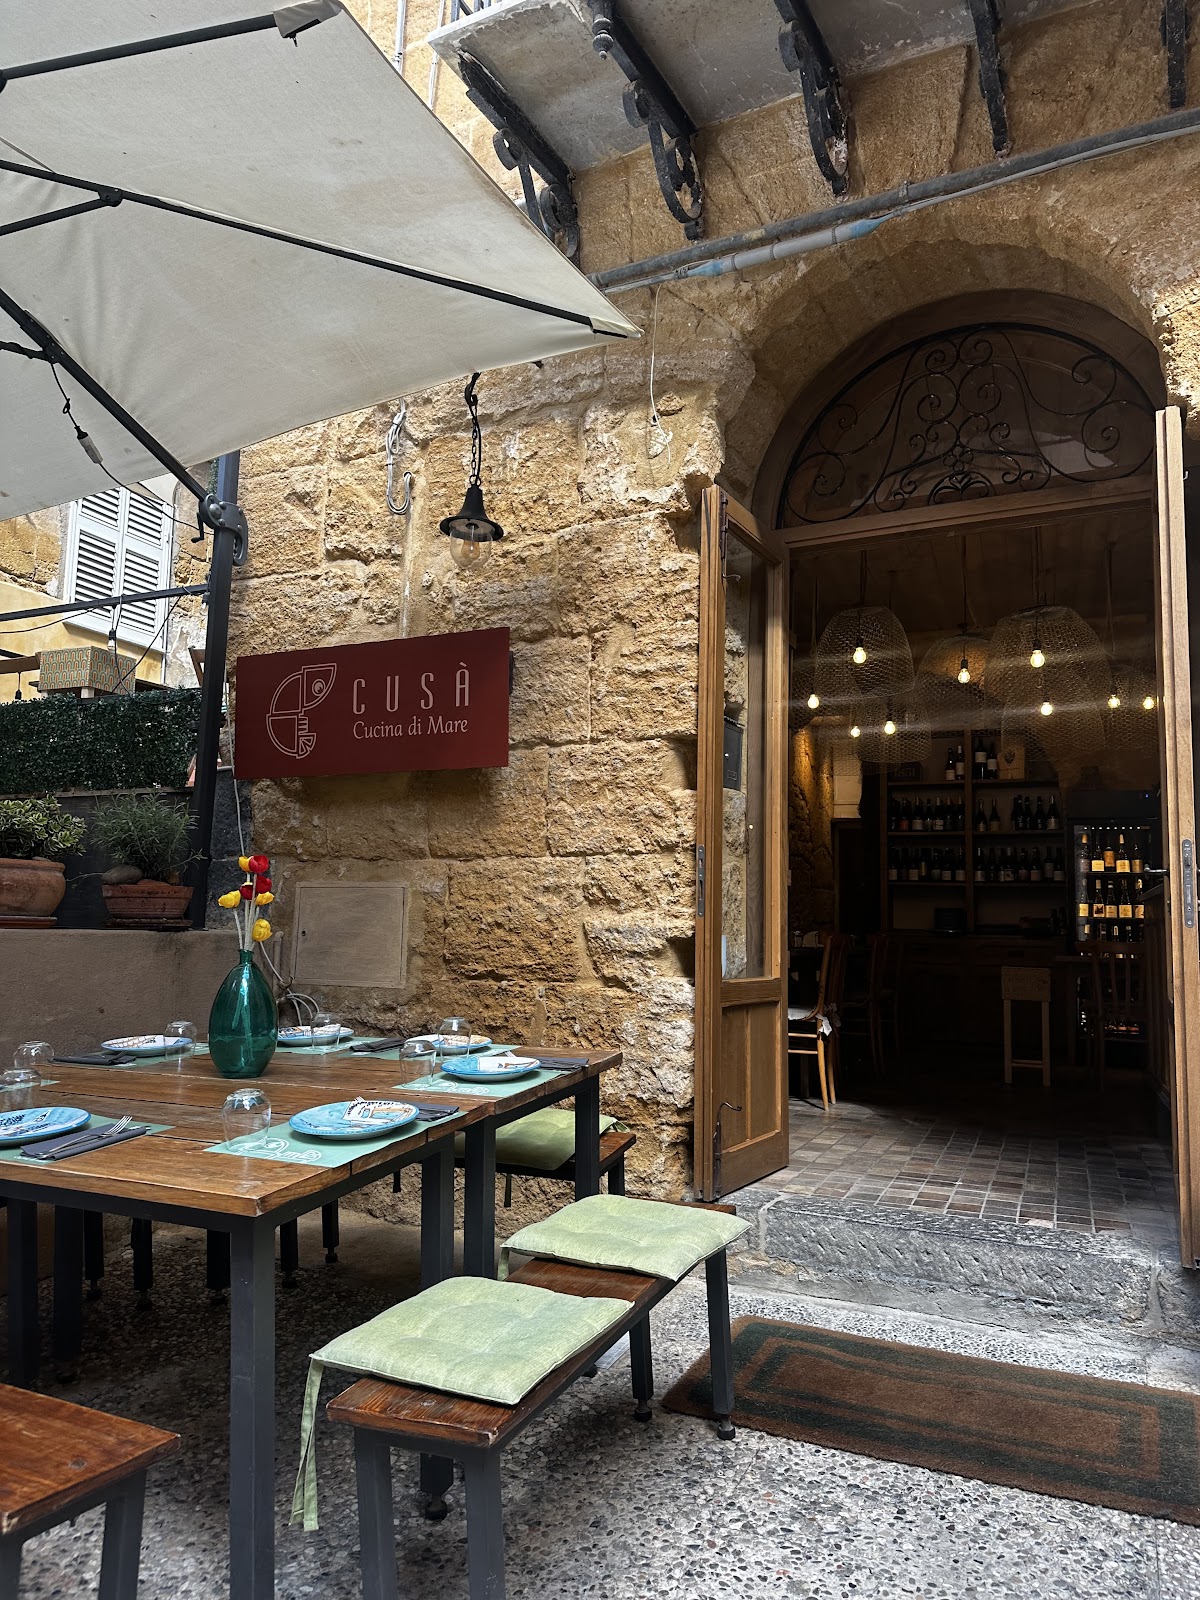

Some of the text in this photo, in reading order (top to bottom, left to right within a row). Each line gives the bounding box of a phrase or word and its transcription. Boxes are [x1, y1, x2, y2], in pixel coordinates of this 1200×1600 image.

[353, 662, 470, 715] CUSÀ
[353, 716, 468, 739] Cucina di Mare
